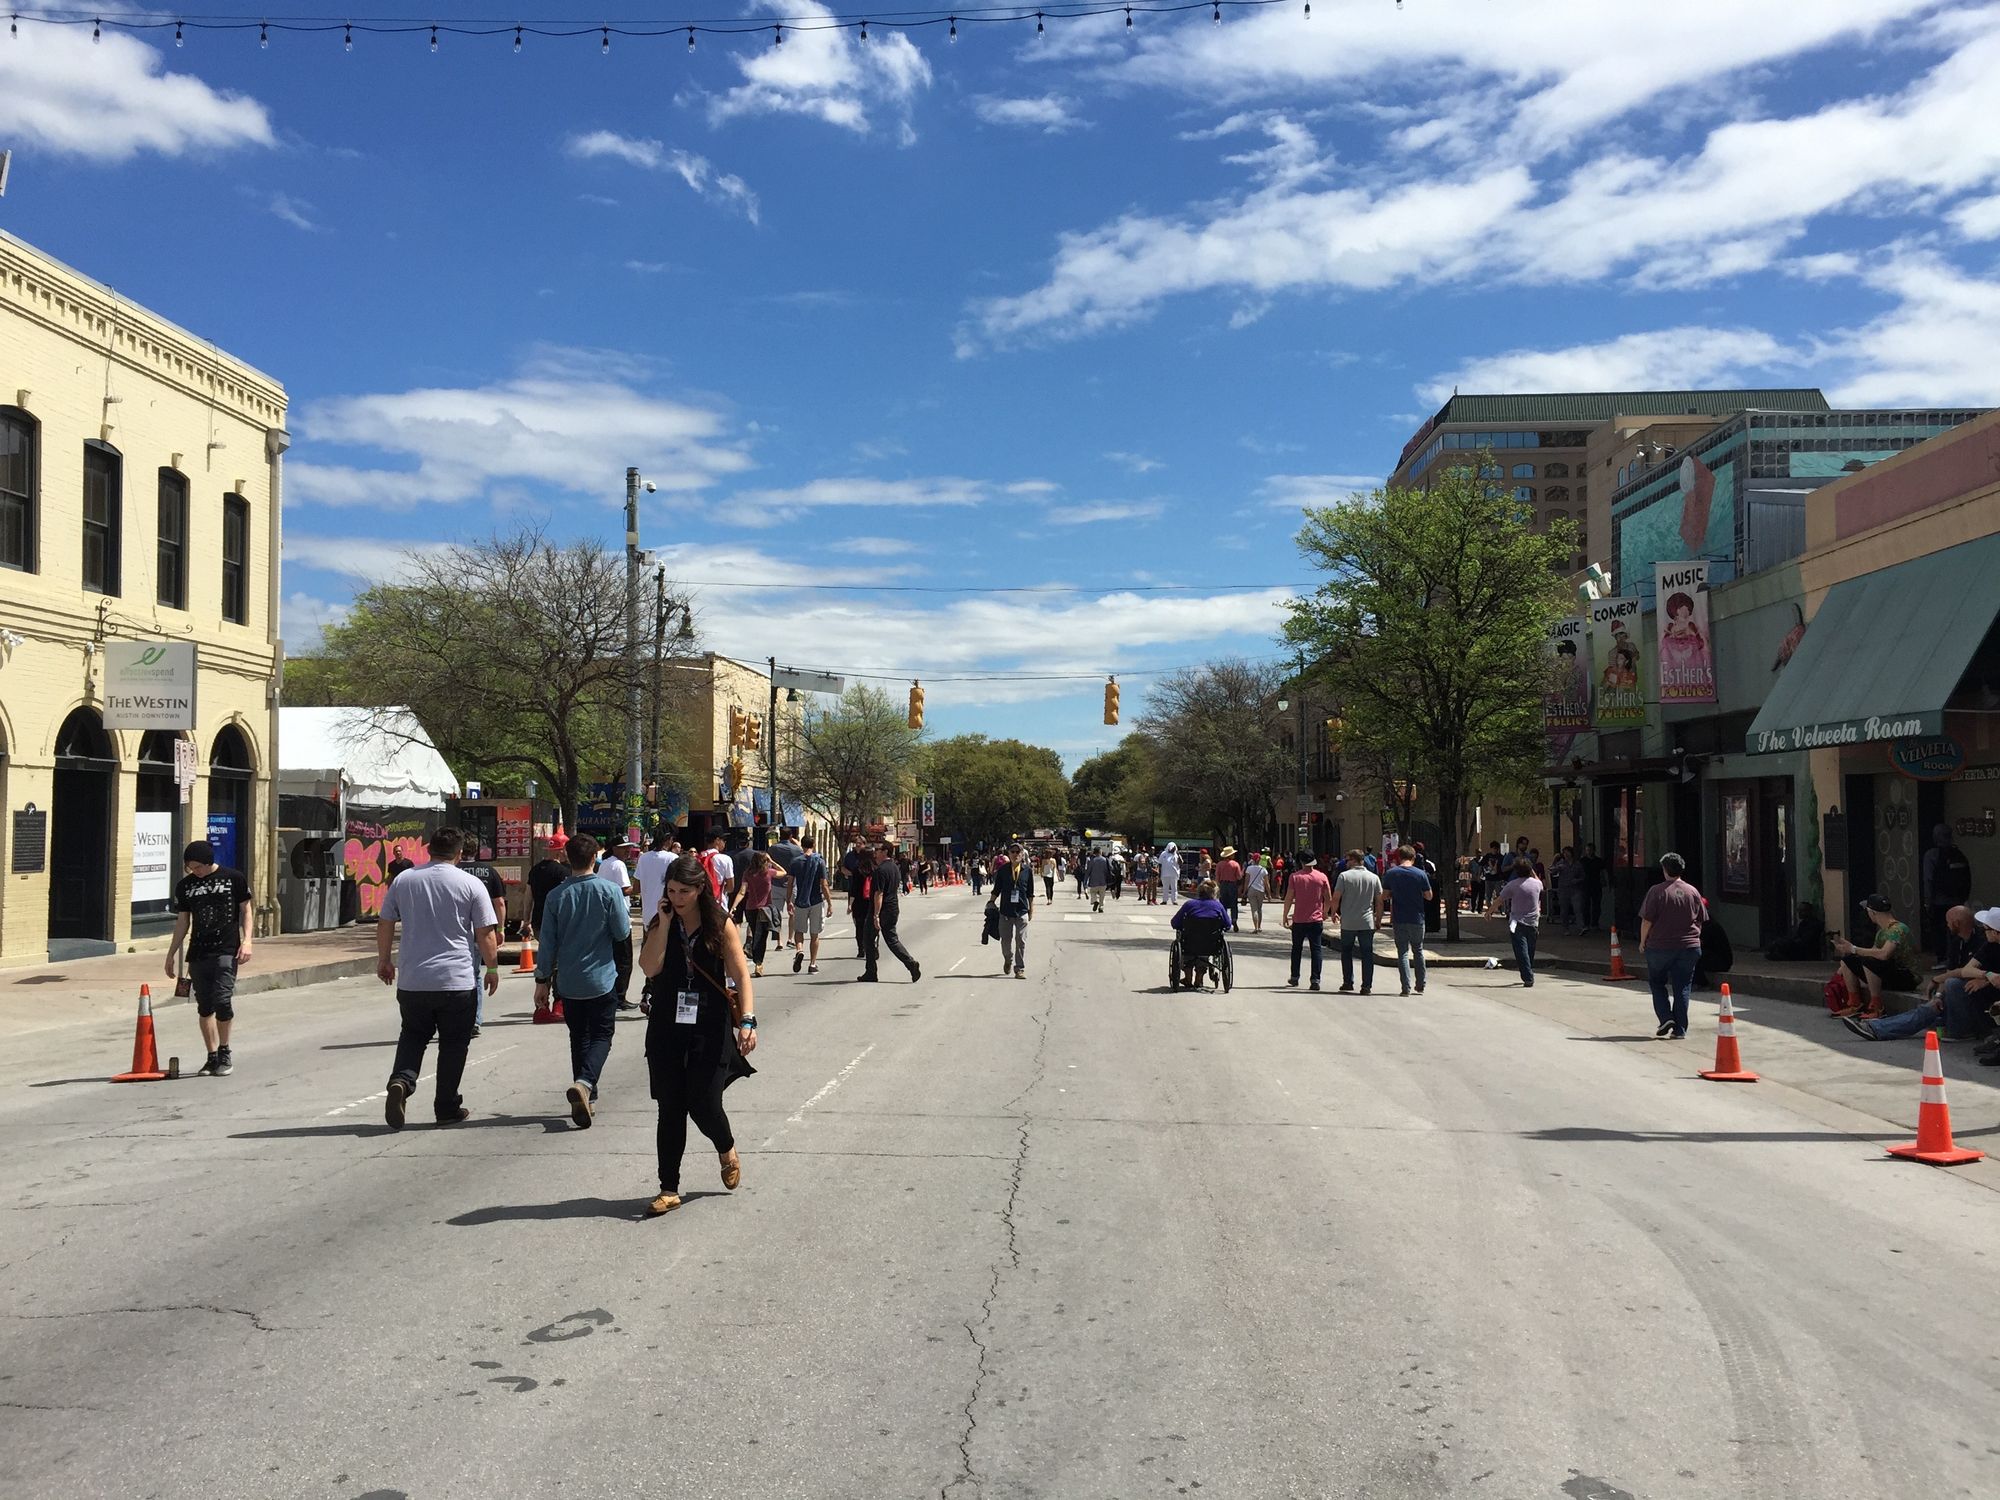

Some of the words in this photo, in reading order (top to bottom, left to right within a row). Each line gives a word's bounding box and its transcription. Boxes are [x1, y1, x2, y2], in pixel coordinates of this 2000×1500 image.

[1662, 567, 1704, 590] MUSIC
[1594, 600, 1639, 622] COMEDY
[1660, 661, 1713, 685] ESTHER'S
[1661, 685, 1713, 698] FOLLIES
[107, 695, 132, 709] THE
[133, 695, 189, 709] WESTIN
[1546, 715, 1589, 727] FOLLIES
[1597, 706, 1644, 720] FOLLIES
[1758, 730, 1786, 753] The
[1792, 723, 1858, 748] Velveeta
[1864, 716, 1922, 741] Room
[1900, 741, 1957, 764] VELVEETA
[1923, 760, 1953, 771] ROOM
[136, 831, 170, 847] WESTIN
